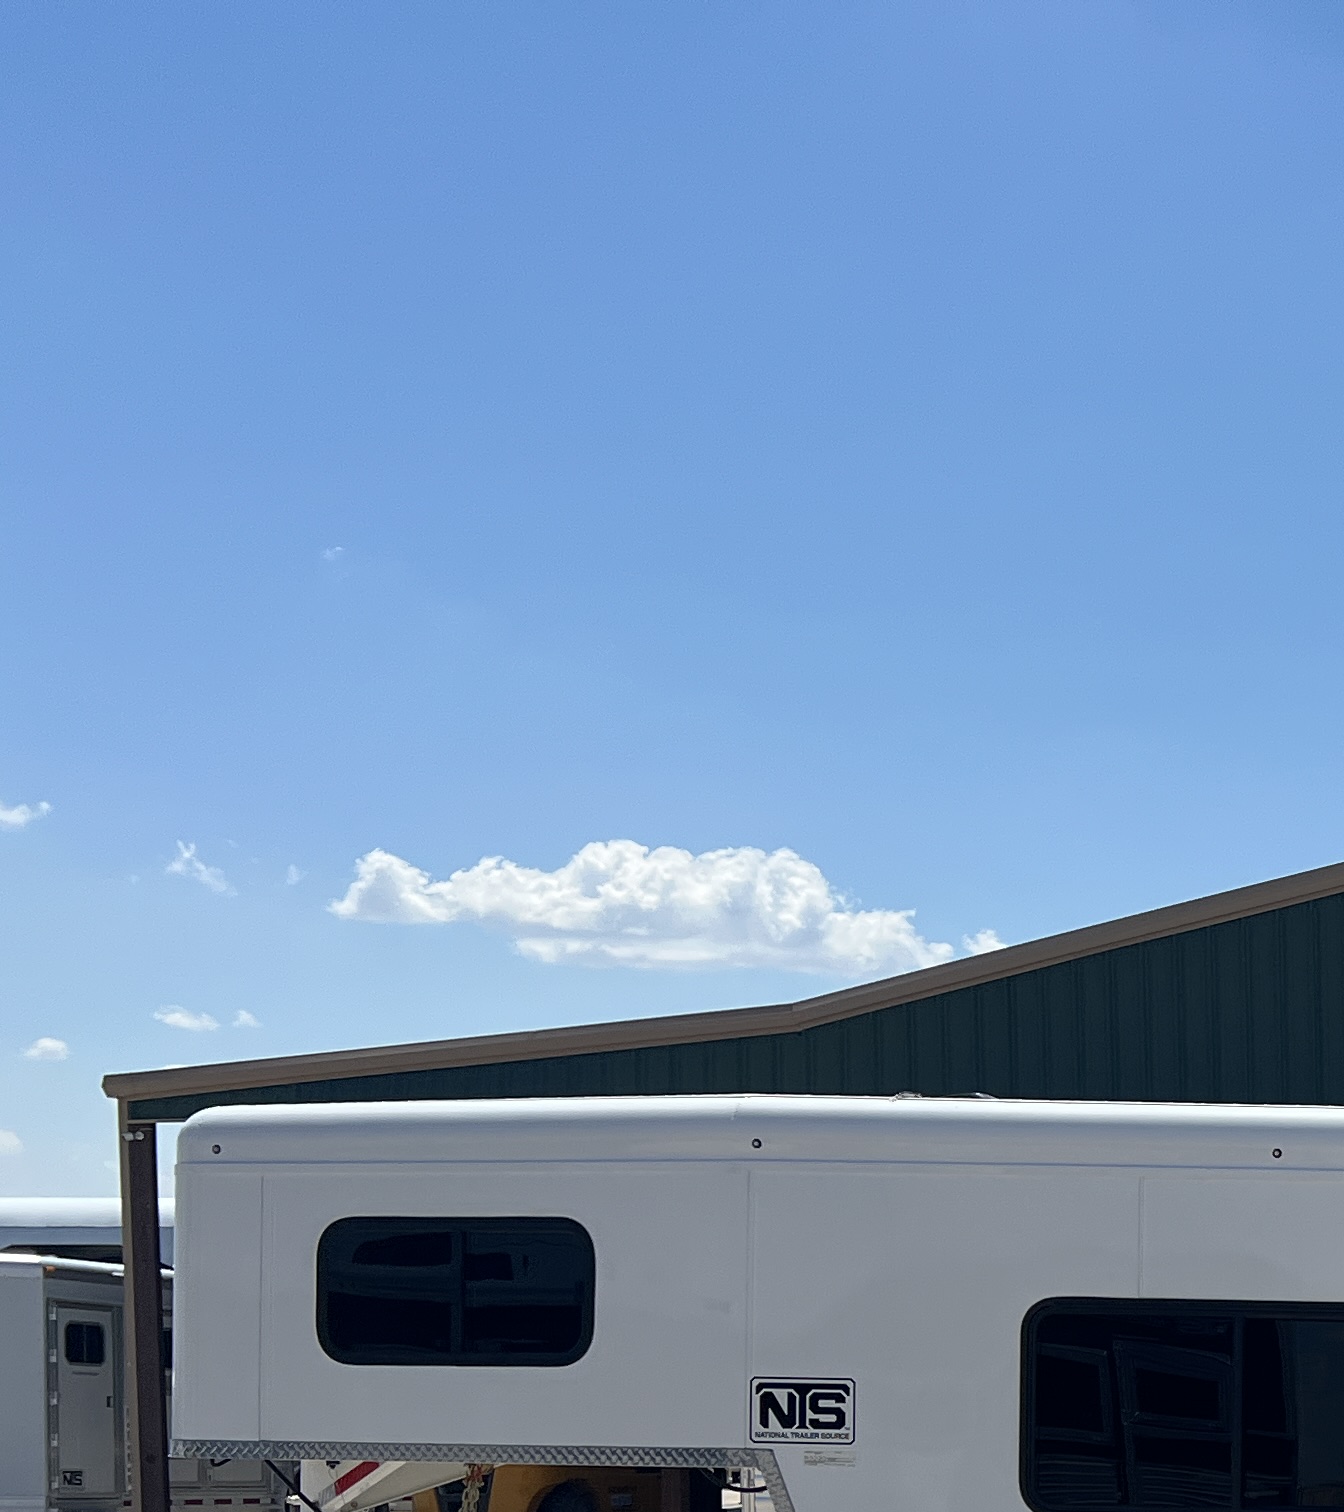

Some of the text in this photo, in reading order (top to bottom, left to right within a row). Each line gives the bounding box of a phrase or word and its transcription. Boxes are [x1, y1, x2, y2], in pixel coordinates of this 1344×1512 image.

[755, 1382, 851, 1431] NTS
[754, 1431, 850, 1441] NATIONAL TRAILER SOURCE
